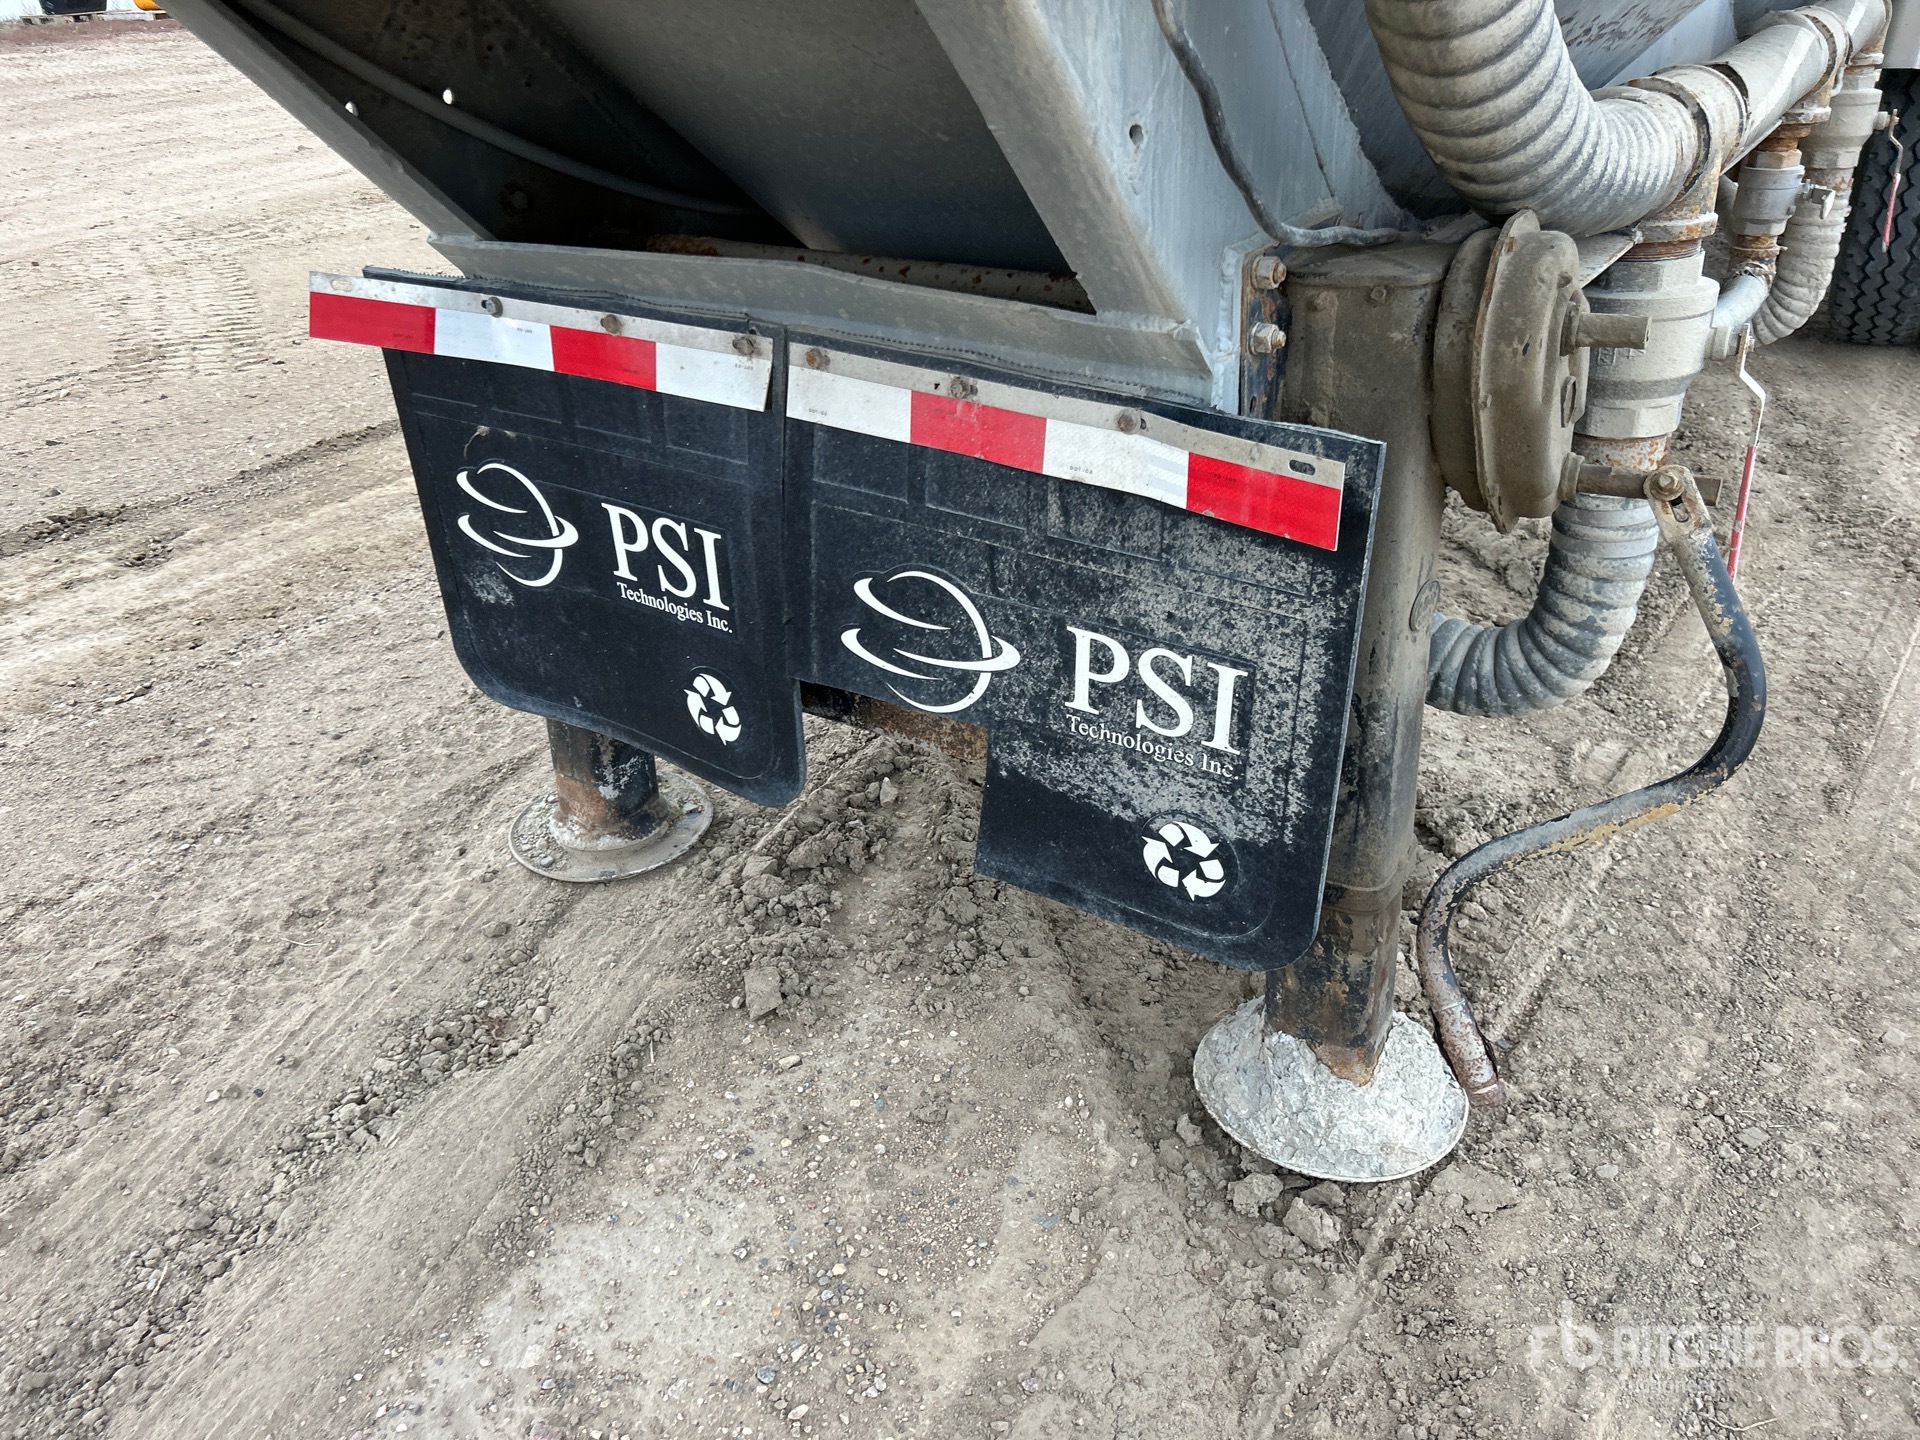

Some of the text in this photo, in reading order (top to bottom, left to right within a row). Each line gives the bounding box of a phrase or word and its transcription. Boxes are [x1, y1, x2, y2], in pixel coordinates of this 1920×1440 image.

[601, 502, 730, 611] PSI
[616, 581, 733, 633] Technologies Inc.
[1064, 625, 1249, 755] PSI
[1066, 713, 1239, 780] Technologies Inc.
